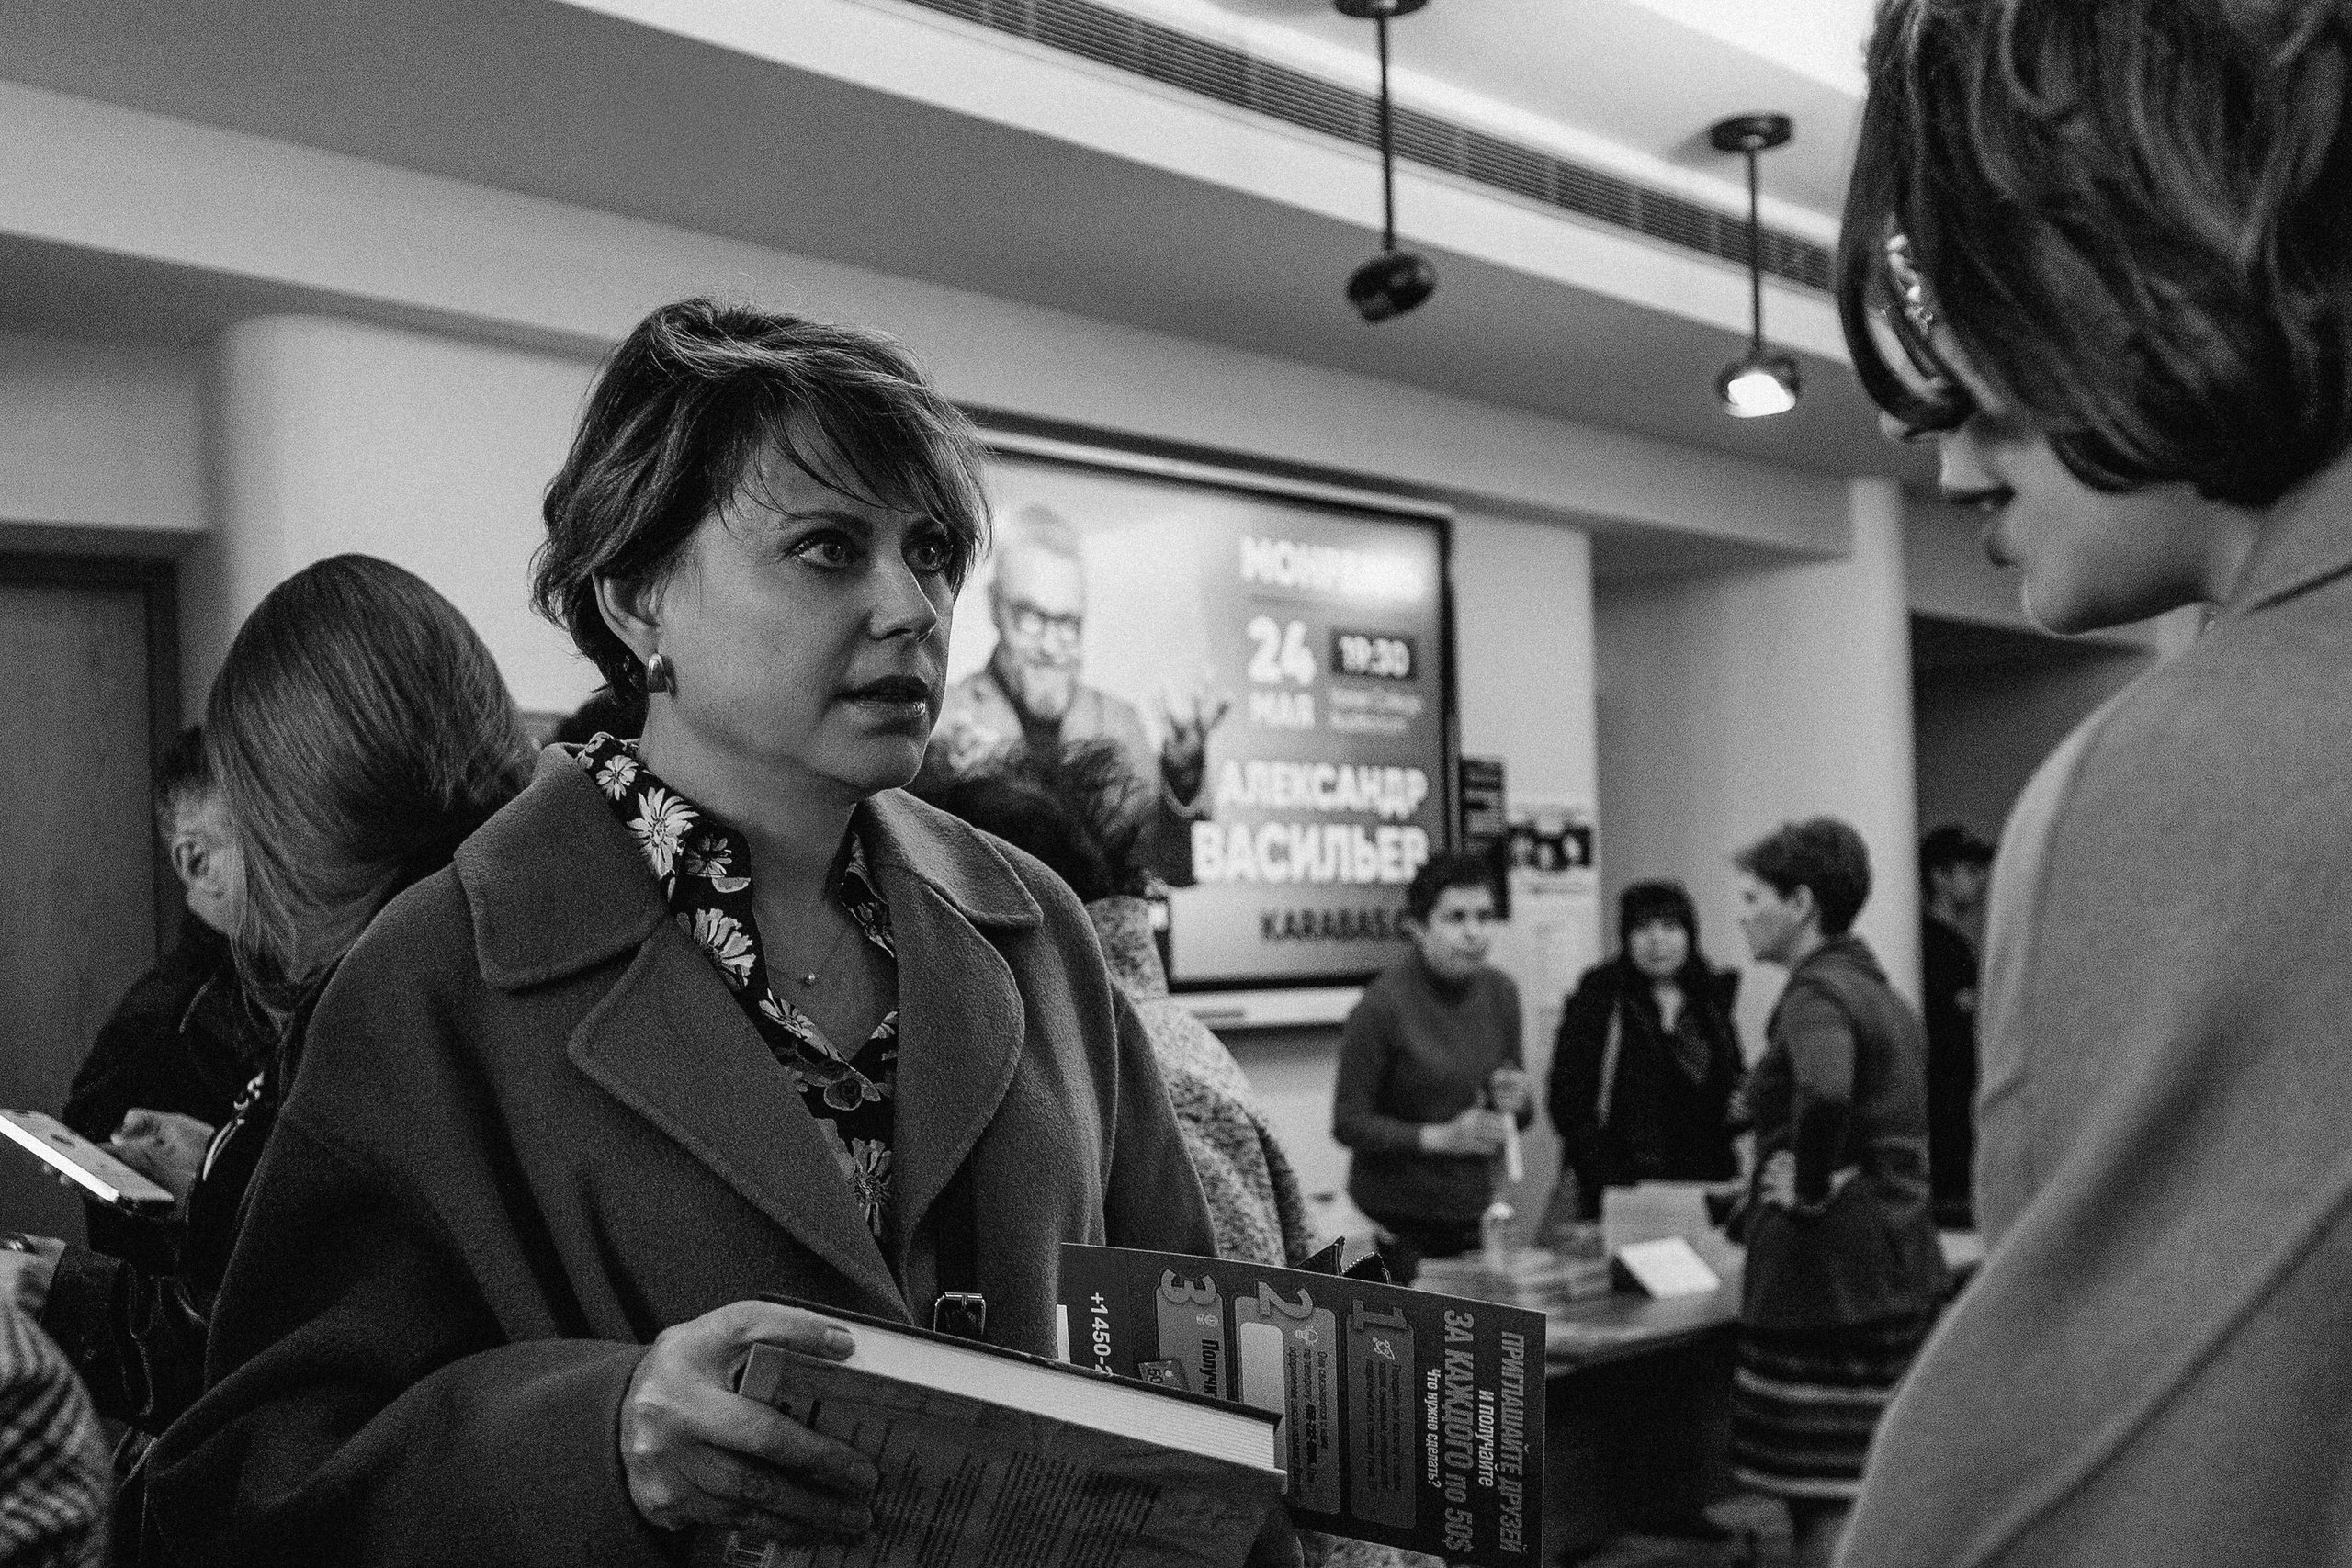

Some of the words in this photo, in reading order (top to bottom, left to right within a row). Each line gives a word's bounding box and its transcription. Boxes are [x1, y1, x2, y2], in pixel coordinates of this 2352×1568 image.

[1247, 616, 1316, 685] 24
[1339, 635, 1410, 678] 19:30
[1248, 692, 1315, 729] МАЯ
[1215, 759, 1428, 819] АЛЕКСАНДР
[1160, 1269, 1218, 1305] 3
[1255, 1280, 1314, 1320] 2
[1351, 1298, 1408, 1332] 1
[1443, 1309, 1475, 1342] ЗА
[1199, 1339, 1220, 1397] Получи
[1427, 1368, 1441, 1390] Что
[1424, 1392, 1440, 1430] нужно
[1442, 1348, 1474, 1470] КАЖДОГО
[1477, 1389, 1495, 1402] и
[1500, 1330, 1530, 1476] ПРИГЛАШАЙТЕ
[1425, 1432, 1442, 1489] сделать?
[1475, 1404, 1498, 1488] получайте
[1442, 1506, 1474, 1554] 50$
[1498, 1476, 1528, 1555] ДРУЗЕЙ
